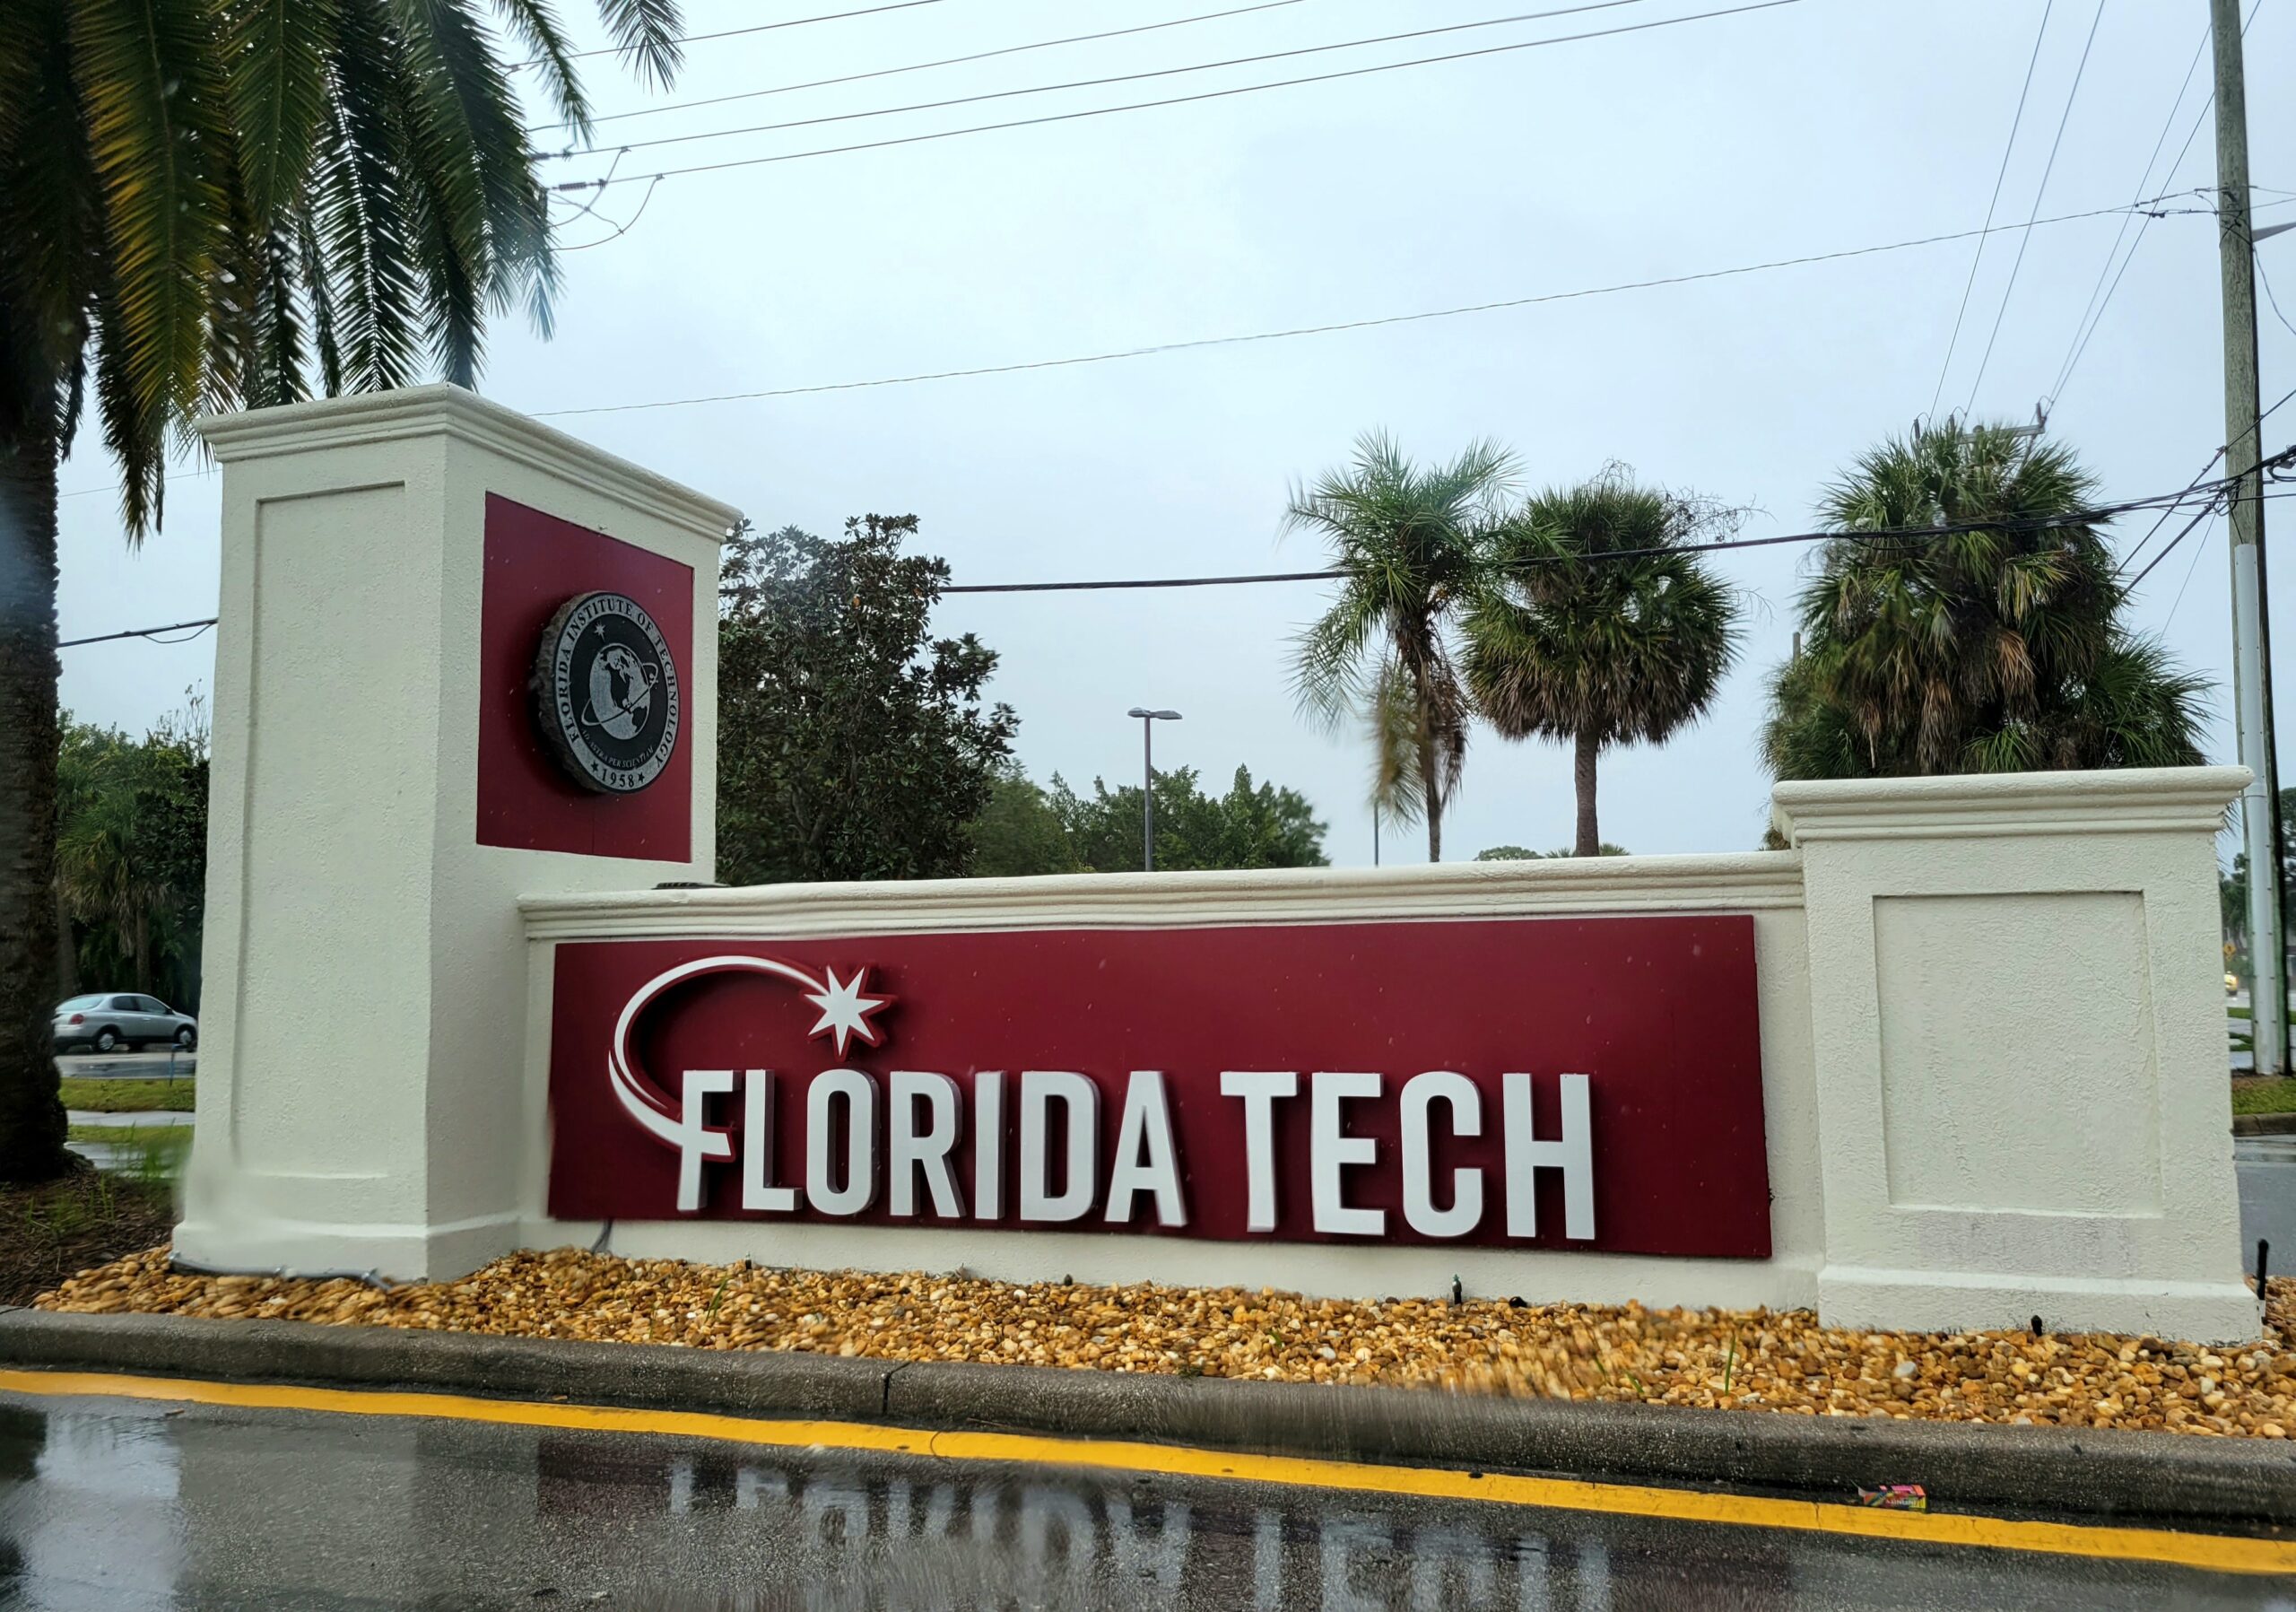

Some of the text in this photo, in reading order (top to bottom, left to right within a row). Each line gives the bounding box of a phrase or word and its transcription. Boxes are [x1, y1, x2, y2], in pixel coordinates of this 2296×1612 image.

[558, 598, 677, 769] FLORIDA INSTITUTE OF TECHNOLOGY
[602, 769, 635, 788] 1958
[608, 756, 622, 767] PER
[622, 744, 655, 768] SCIENTIAM
[677, 1068, 1596, 1241] FLORIDA TECH
